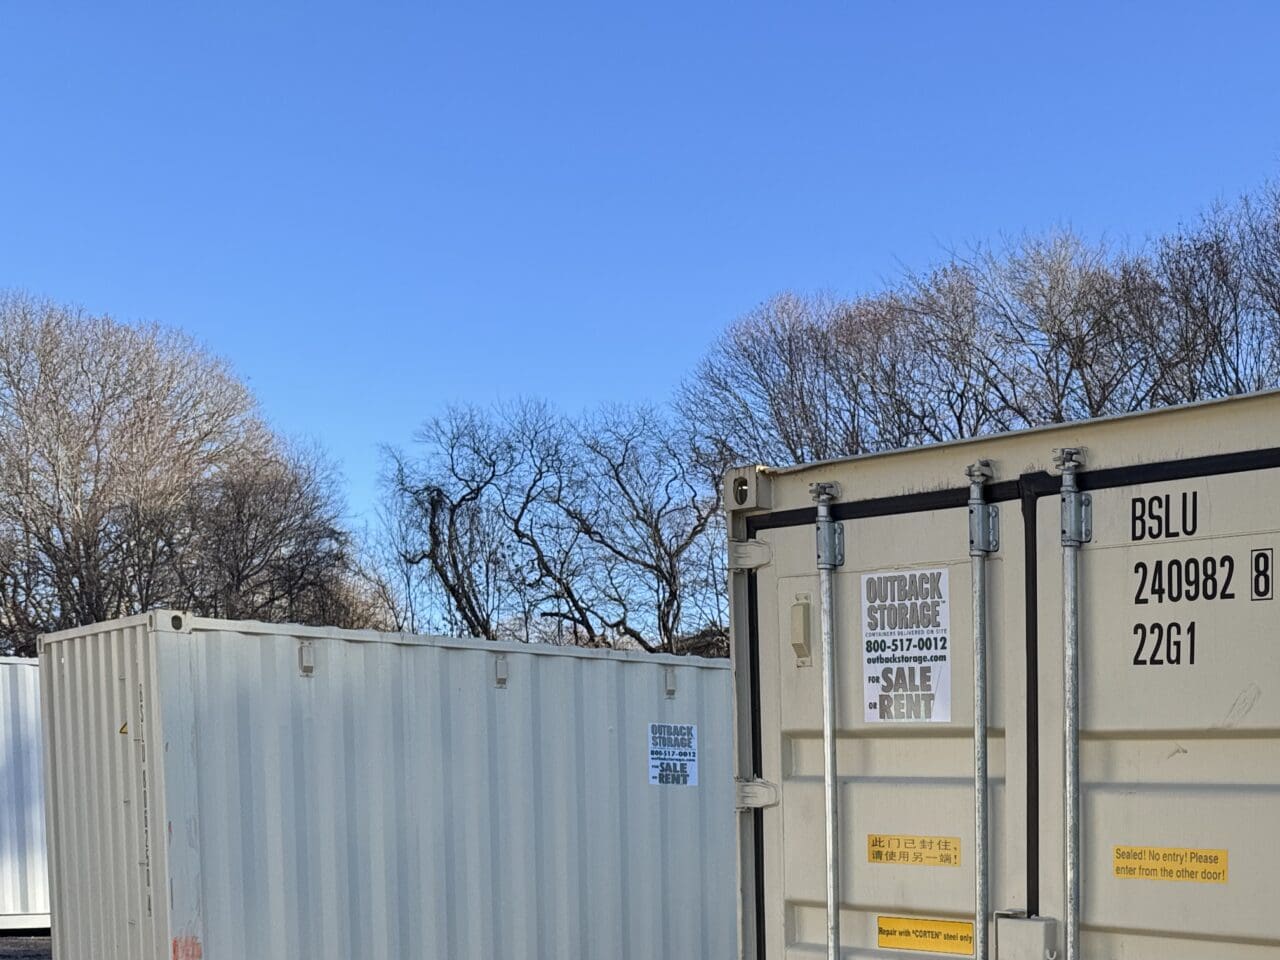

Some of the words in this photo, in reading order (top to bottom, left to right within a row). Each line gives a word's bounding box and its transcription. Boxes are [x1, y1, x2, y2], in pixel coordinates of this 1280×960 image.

[1131, 491, 1198, 541] BSLU
[866, 571, 943, 604] OUTBACK
[1134, 555, 1236, 605] 240982
[1253, 552, 1271, 598] 8
[867, 600, 941, 631] STORAGE
[865, 636, 947, 653] 800-517-0012
[1133, 621, 1196, 666] 22G1
[866, 653, 947, 665] outbackstorage.com
[868, 676, 880, 684] FOR
[881, 666, 932, 693] SALE
[868, 702, 877, 710] OR
[879, 693, 935, 720] RENT
[651, 724, 693, 737] OUTBACK
[660, 762, 687, 773] SALE
[659, 773, 689, 784] RENT
[1115, 848, 1146, 860] Sealed!
[1148, 850, 1160, 861] No
[1162, 851, 1188, 865] entry!
[1189, 851, 1219, 864] Please
[1115, 865, 1136, 875] enter
[1138, 865, 1158, 877] from
[1160, 867, 1174, 878] the
[1175, 867, 1199, 879] other
[1200, 869, 1225, 881] door!
[878, 927, 897, 938] Repair
[898, 929, 911, 937] with
[943, 933, 959, 941] steel
[959, 934, 972, 945] only
